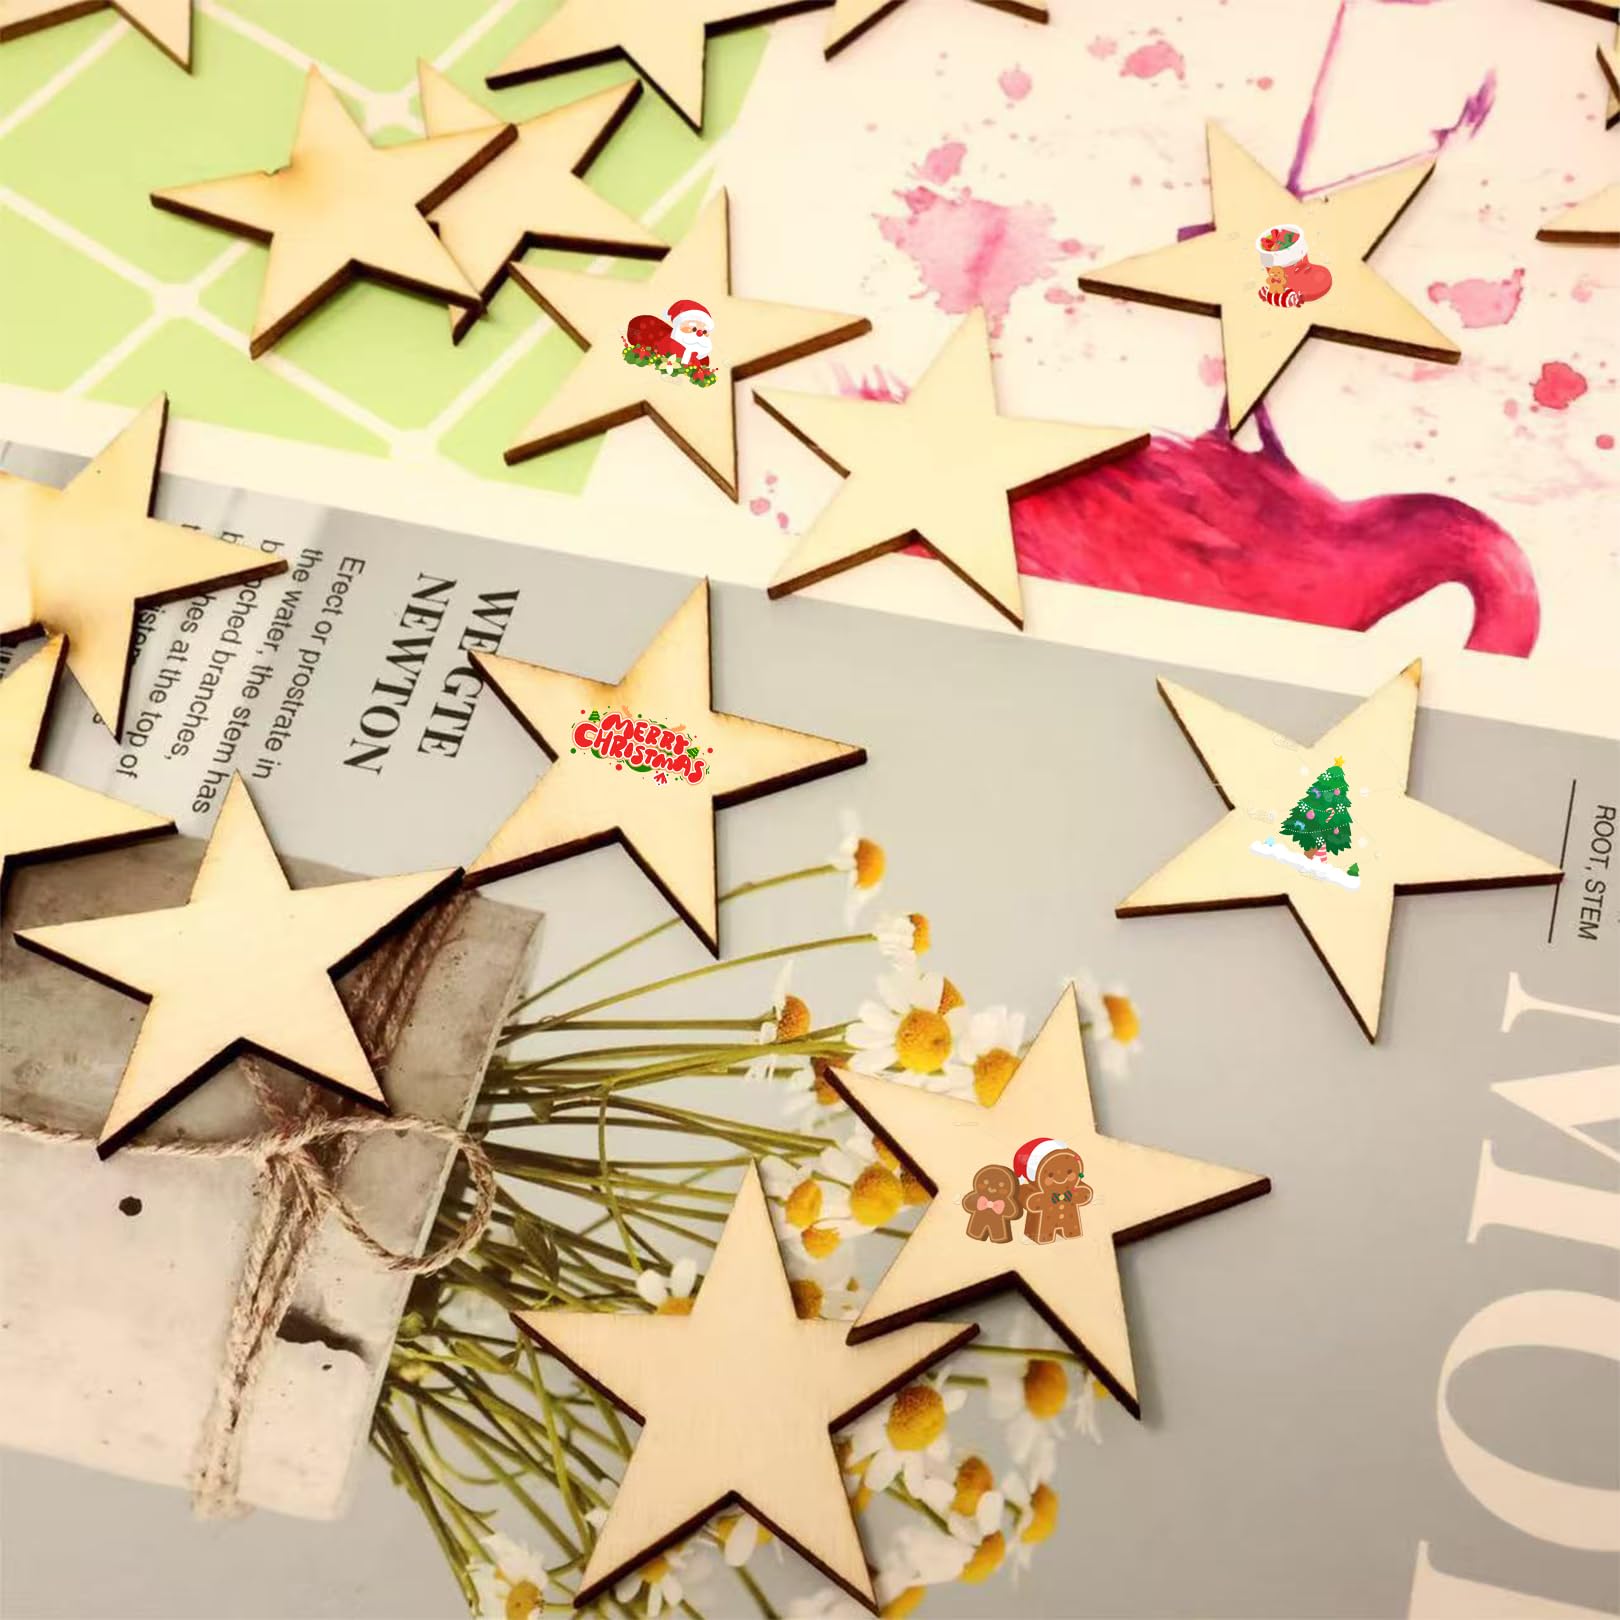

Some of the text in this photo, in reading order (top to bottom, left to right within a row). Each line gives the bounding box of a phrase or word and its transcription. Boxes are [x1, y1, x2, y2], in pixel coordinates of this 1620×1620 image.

[292, 548, 323, 583] the
[166, 639, 190, 662] at
[251, 556, 366, 780] Erect or prostrate in
[149, 668, 182, 704] the
[241, 664, 274, 700] the
[343, 571, 458, 776] NEWTON
[164, 649, 237, 760] branches,
[126, 711, 163, 748] top
[216, 706, 252, 764] stem
[600, 713, 690, 756] MERRY
[116, 754, 138, 779] of
[573, 722, 706, 784] CHRISTMAS
[192, 770, 230, 814] has
[1577, 804, 1617, 941] ROOT, STEM
